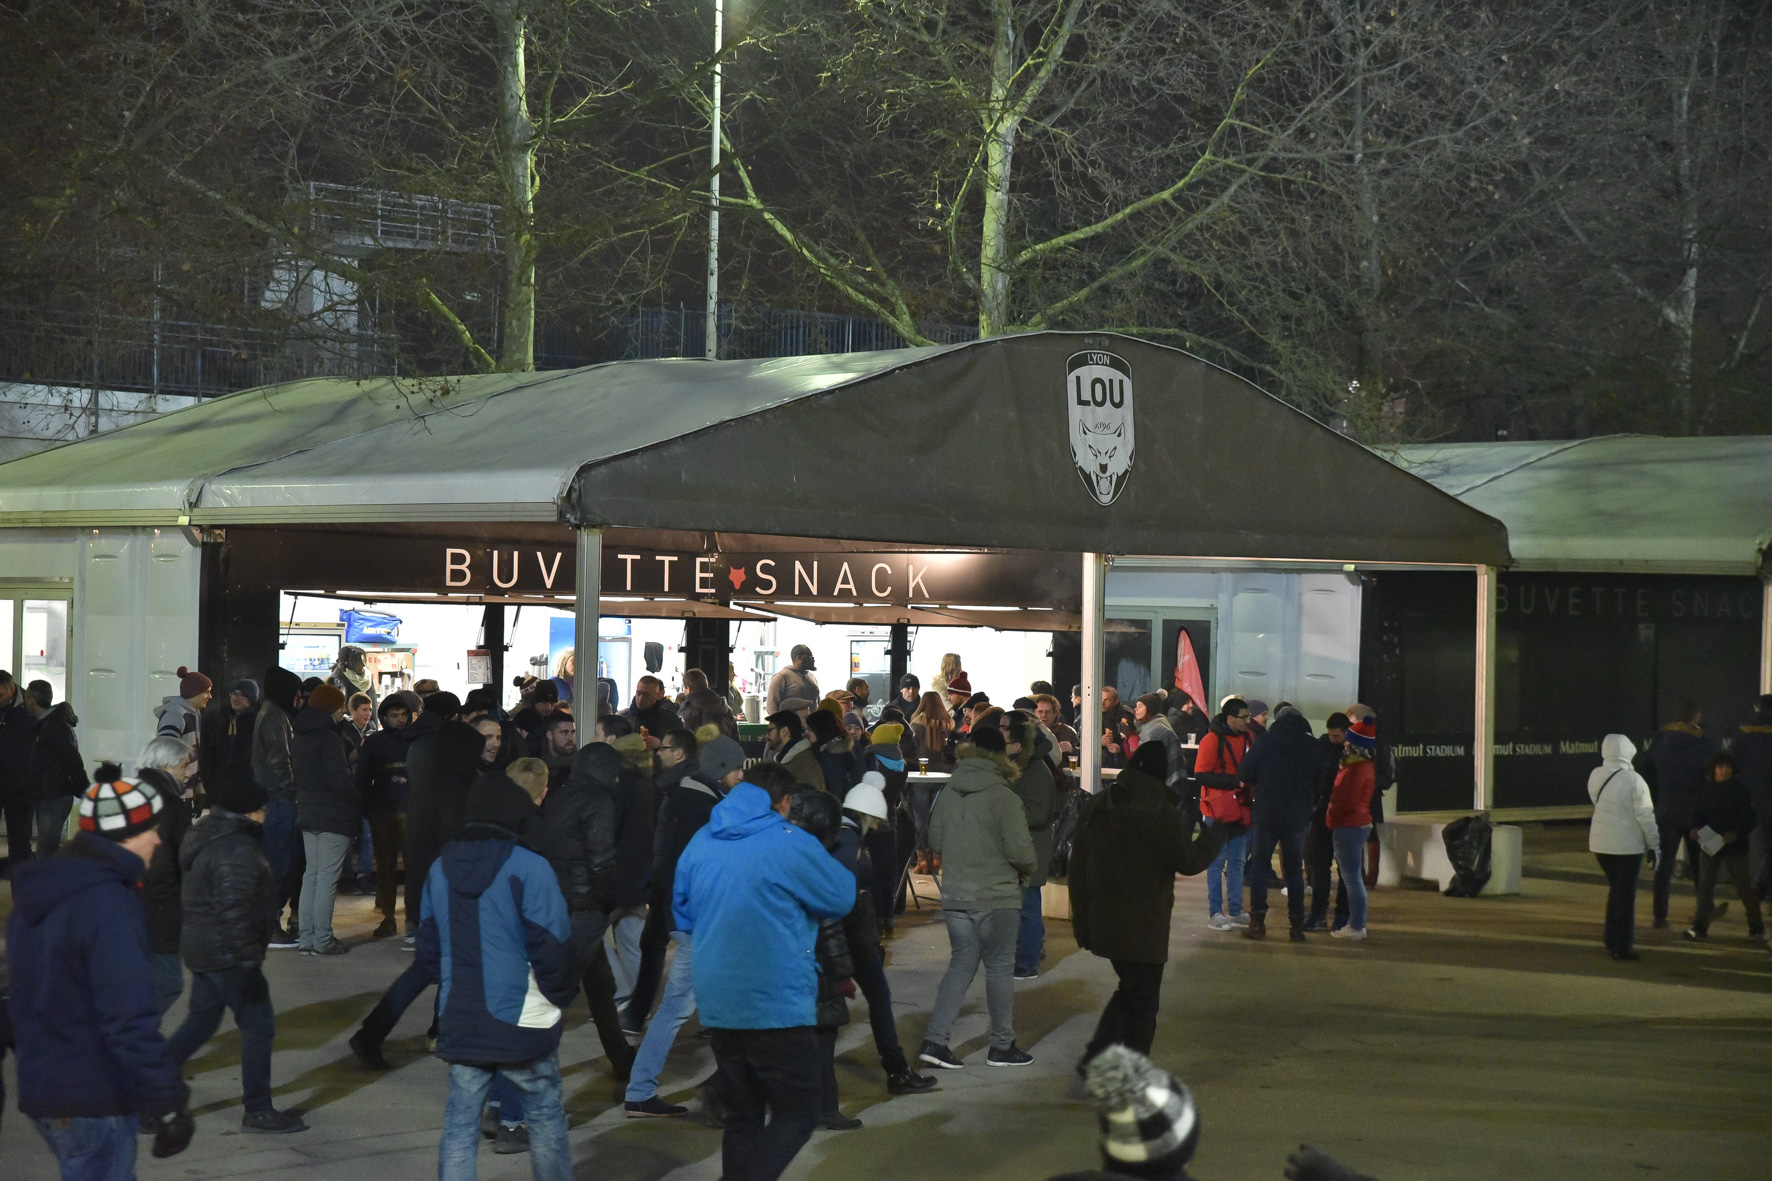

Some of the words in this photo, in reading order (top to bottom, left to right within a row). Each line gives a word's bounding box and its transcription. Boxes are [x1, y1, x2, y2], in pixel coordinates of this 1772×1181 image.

[1087, 353, 1110, 366] LYON
[1075, 375, 1125, 409] LOU
[1094, 421, 1112, 431] 1896
[445, 548, 716, 594] BUVTTE
[755, 559, 930, 599] SNACK
[1496, 584, 1650, 617] BUVETTE
[1671, 589, 1752, 619] SNAC
[1391, 743, 1424, 758] atmut
[1426, 745, 1465, 757] STADIUM
[1515, 744, 1552, 755] STADIUM
[1559, 740, 1598, 754] Matmut
